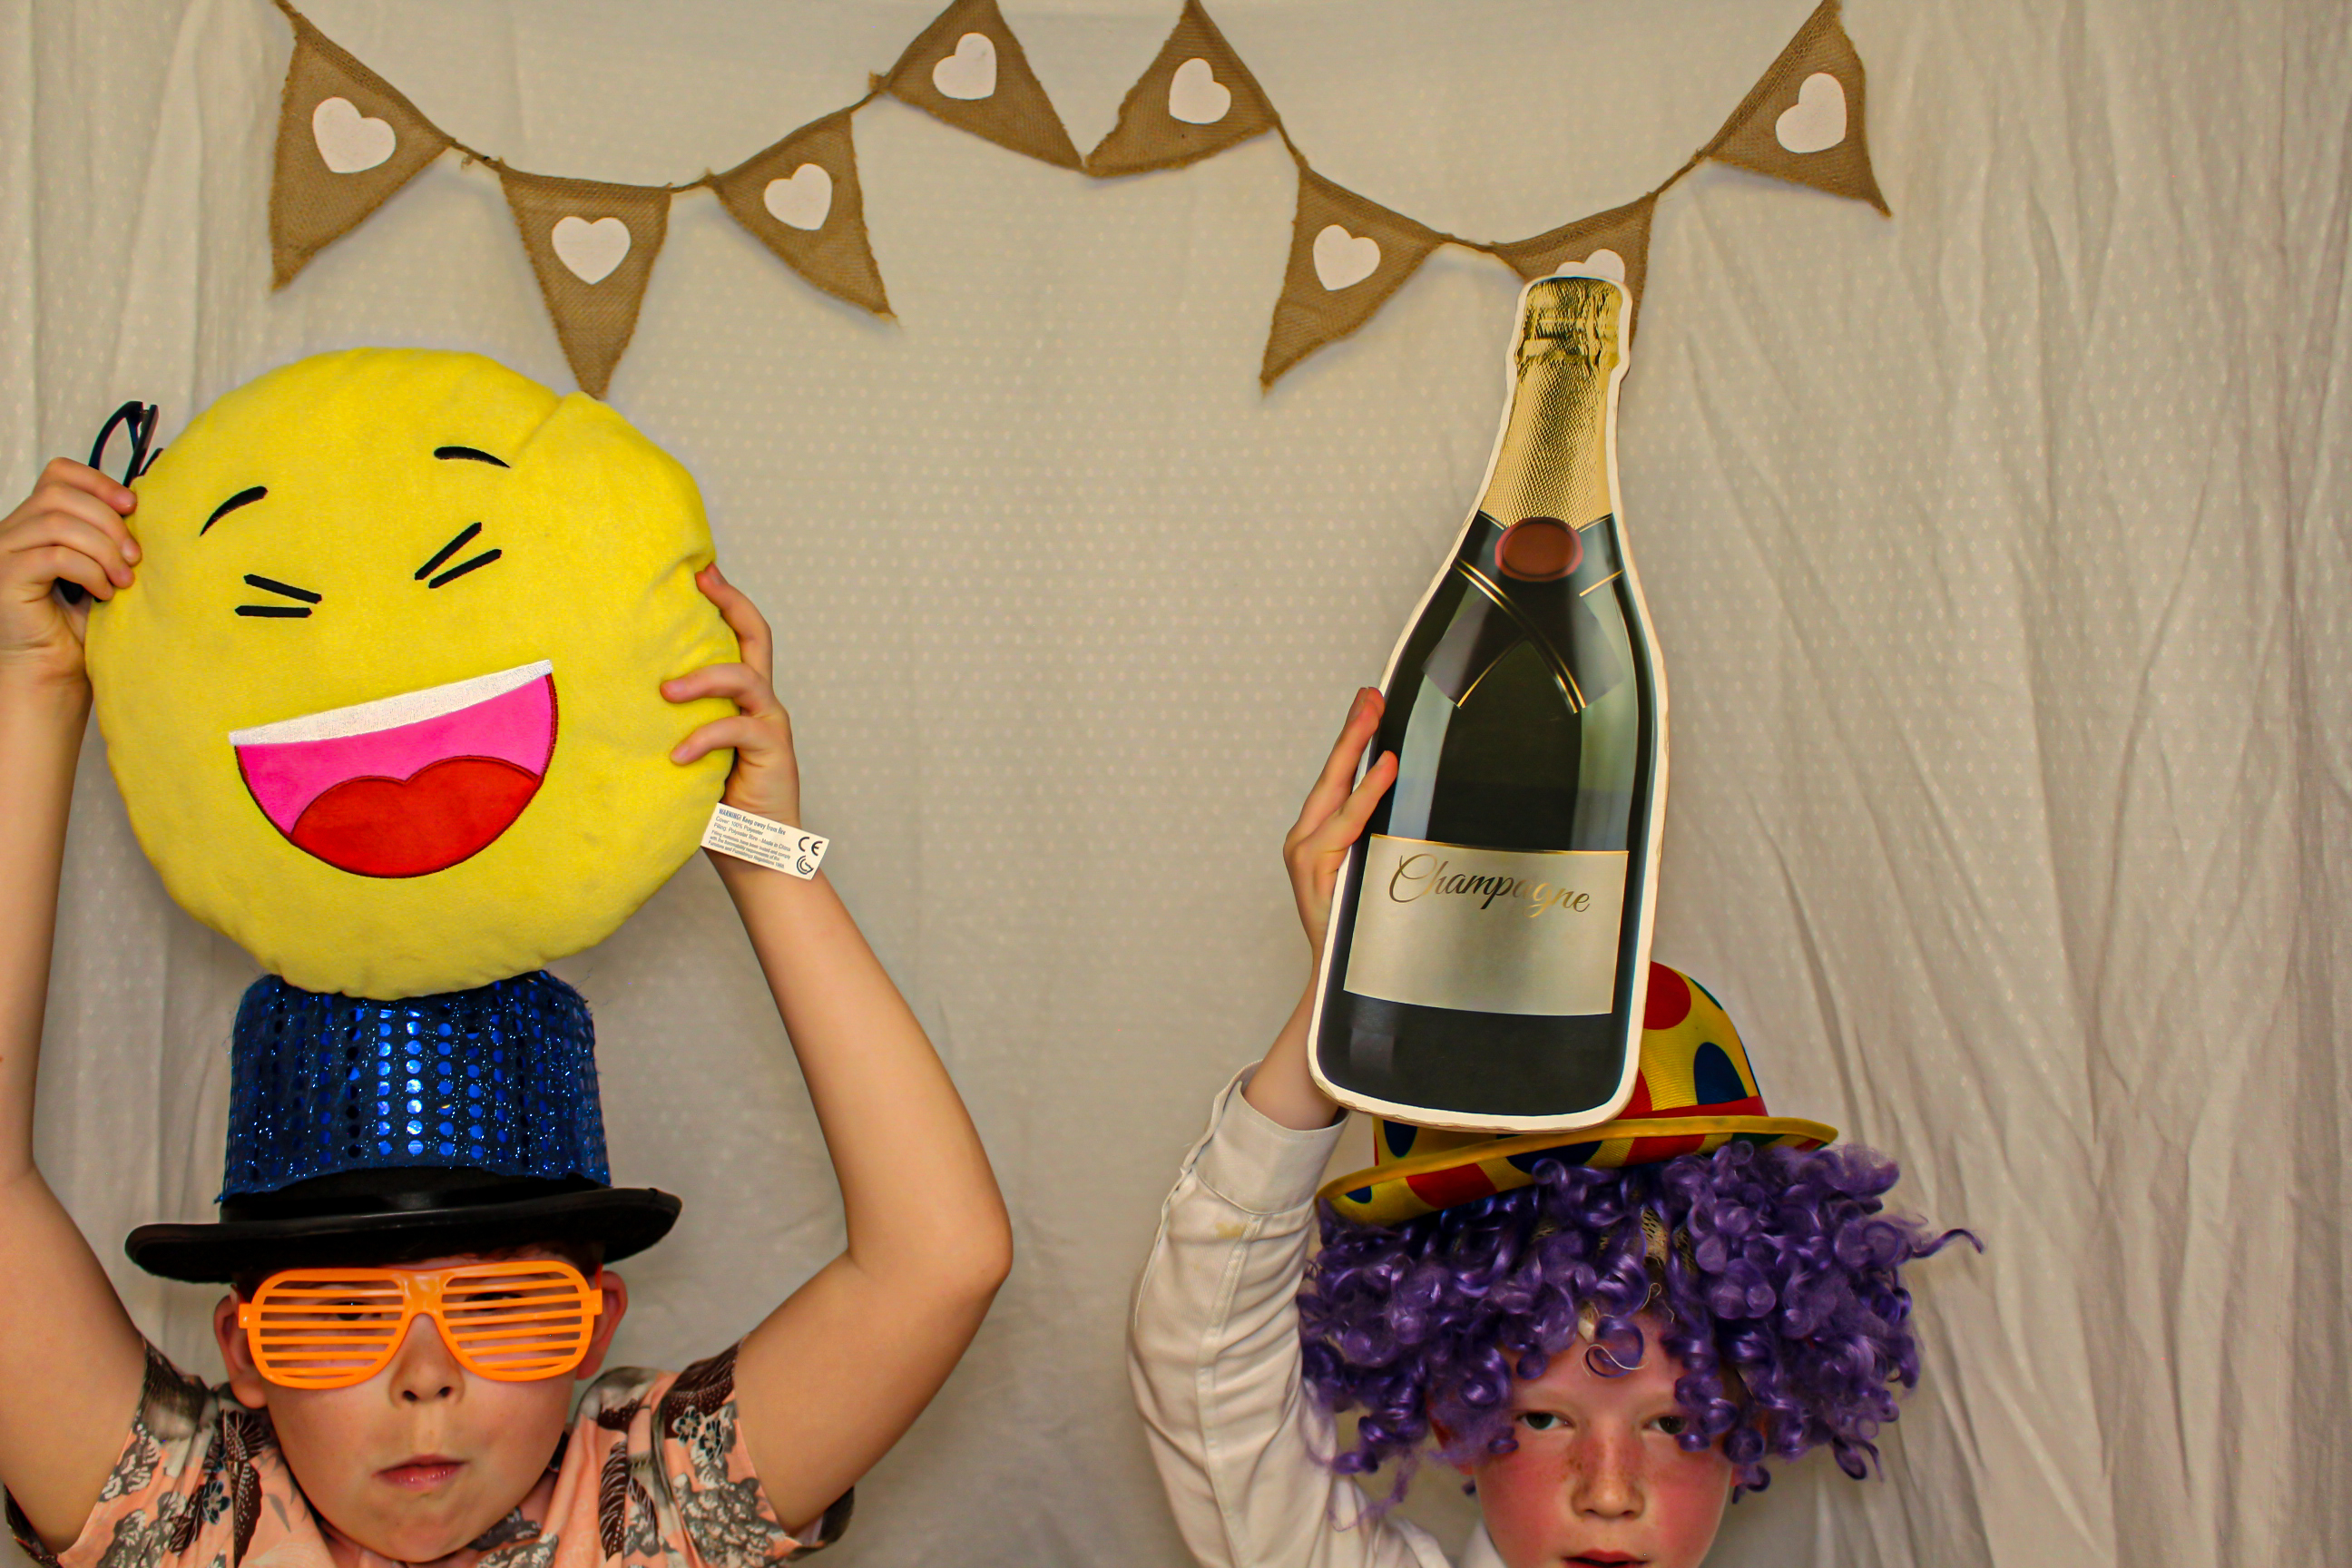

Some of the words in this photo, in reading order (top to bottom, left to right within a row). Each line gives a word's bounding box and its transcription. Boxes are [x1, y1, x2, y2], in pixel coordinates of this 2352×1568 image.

[742, 816, 753, 826] Keep
[754, 821, 766, 829] away
[767, 823, 777, 832] from
[762, 838, 773, 847] Made
[779, 844, 790, 852] China
[1389, 853, 1590, 918] Champagne
